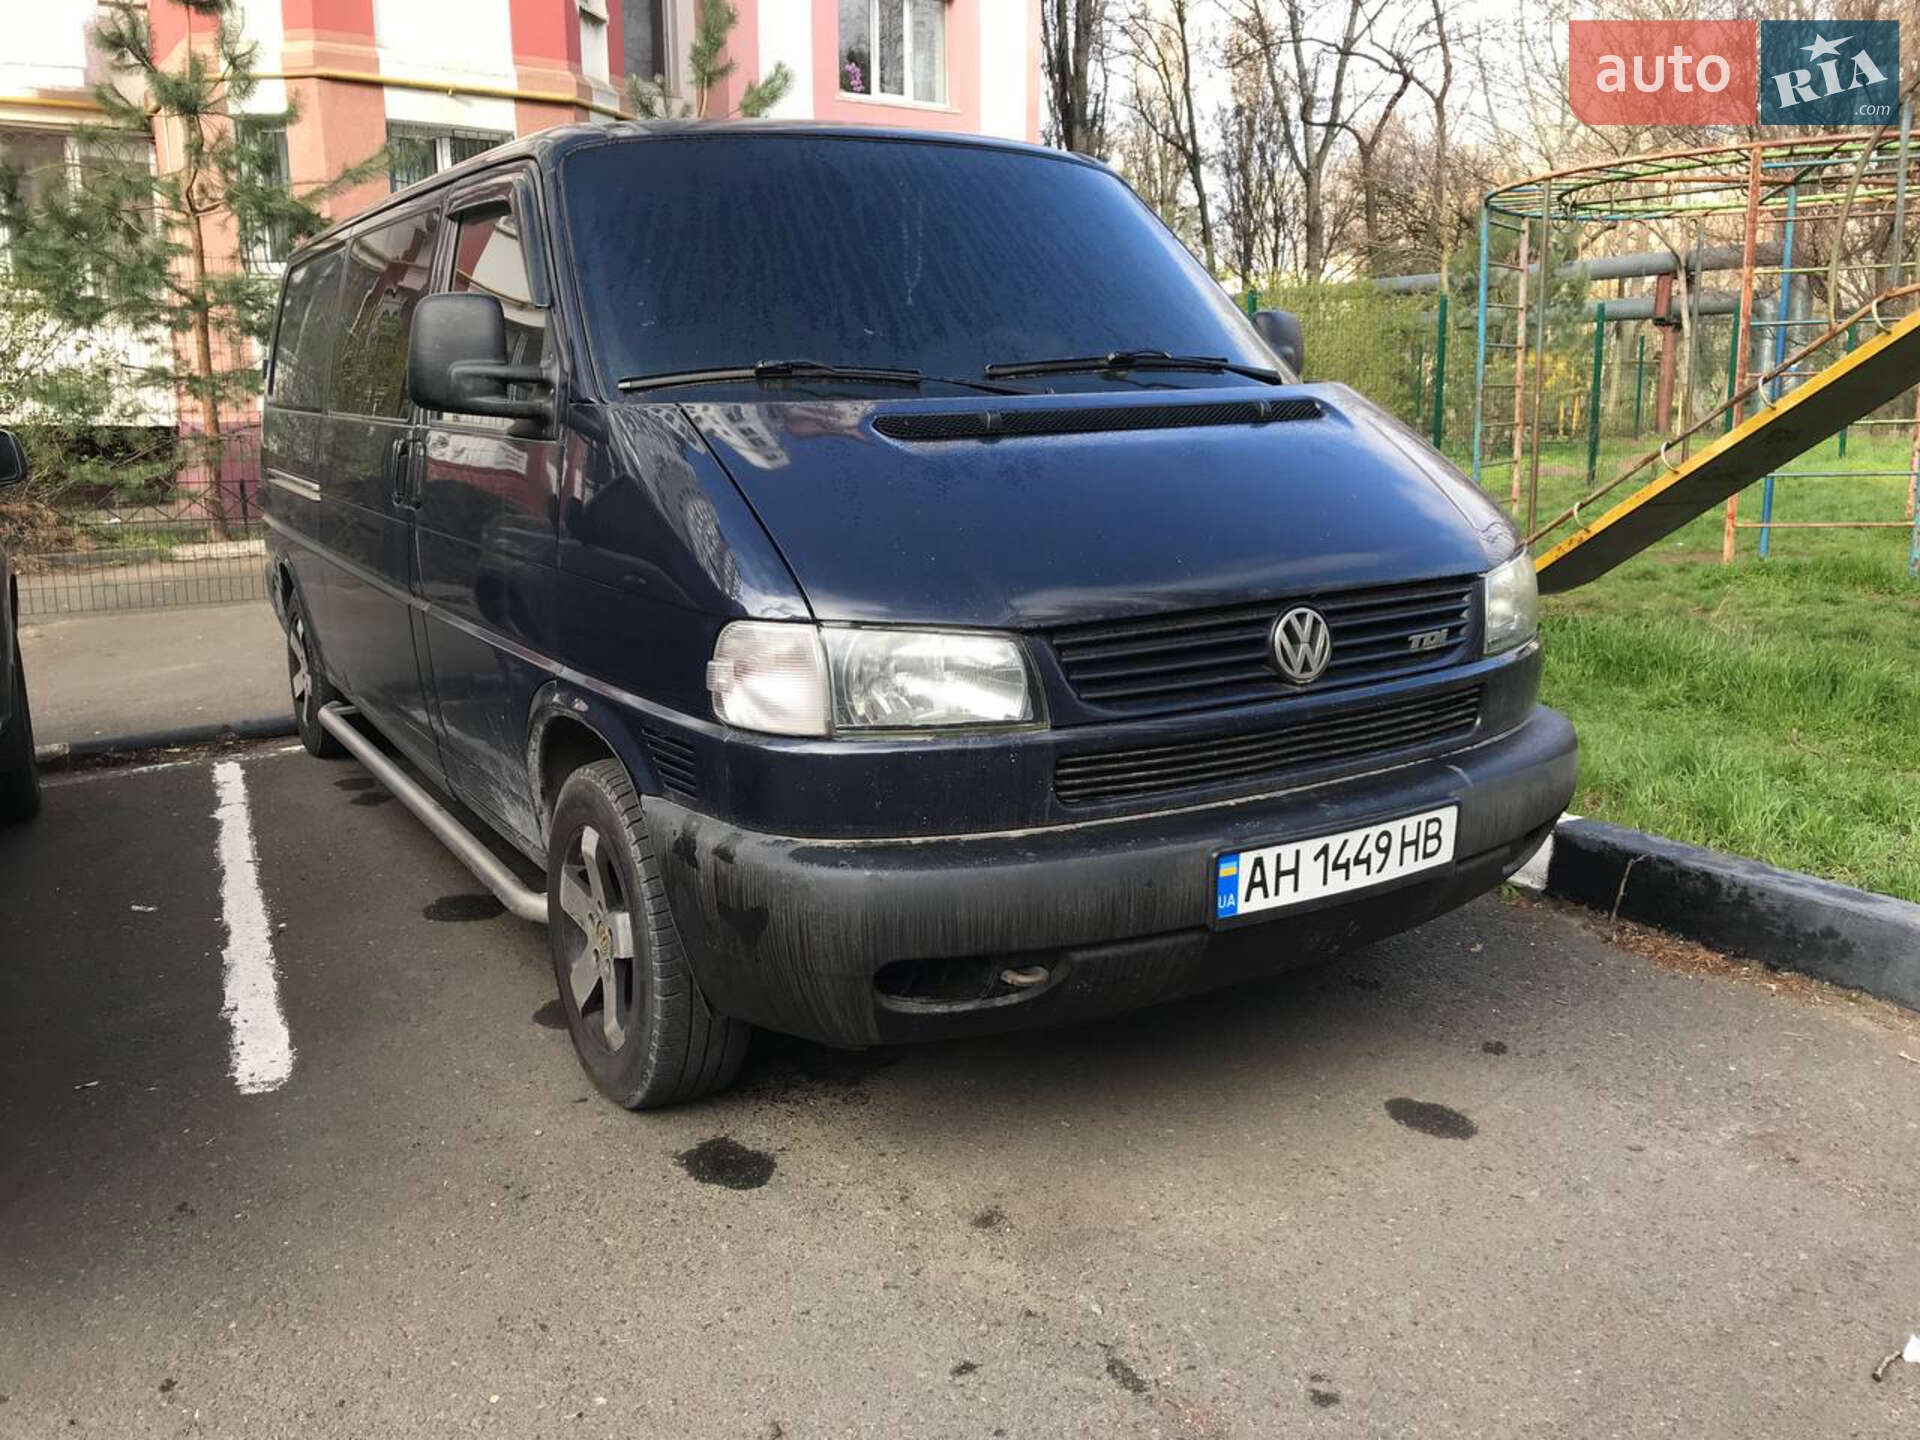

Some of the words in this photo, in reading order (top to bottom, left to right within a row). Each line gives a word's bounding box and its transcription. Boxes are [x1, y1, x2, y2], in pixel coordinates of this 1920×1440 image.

[1408, 628, 1449, 650] TDI
[1245, 849, 1300, 902] AH
[1314, 830, 1392, 886] 1449
[1400, 817, 1442, 866] HB
[1218, 895, 1236, 909] UA
